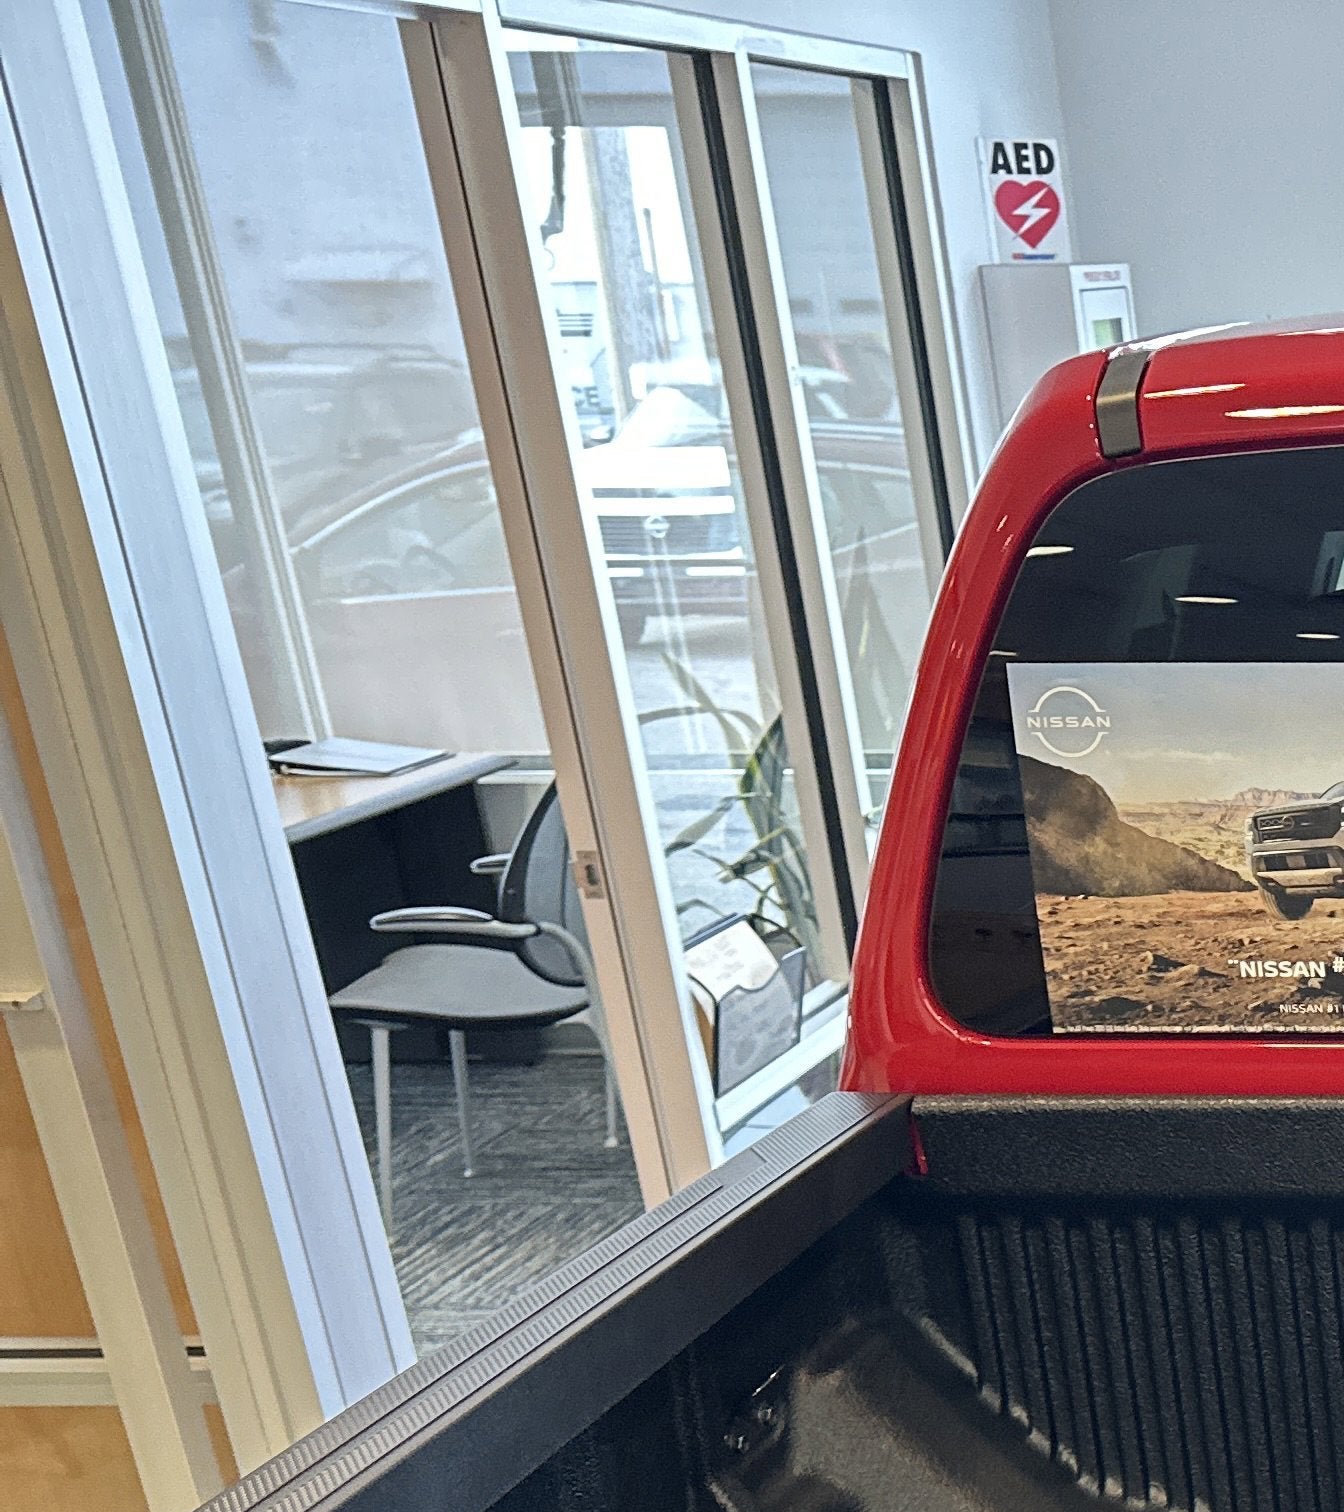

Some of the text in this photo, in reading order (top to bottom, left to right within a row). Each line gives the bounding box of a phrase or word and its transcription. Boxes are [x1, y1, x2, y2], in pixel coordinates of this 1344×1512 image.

[990, 142, 1055, 175] AED
[1026, 715, 1111, 728] NISSAN
[1279, 1003, 1324, 1014] NISSAN
[1326, 1003, 1339, 1014] #1
